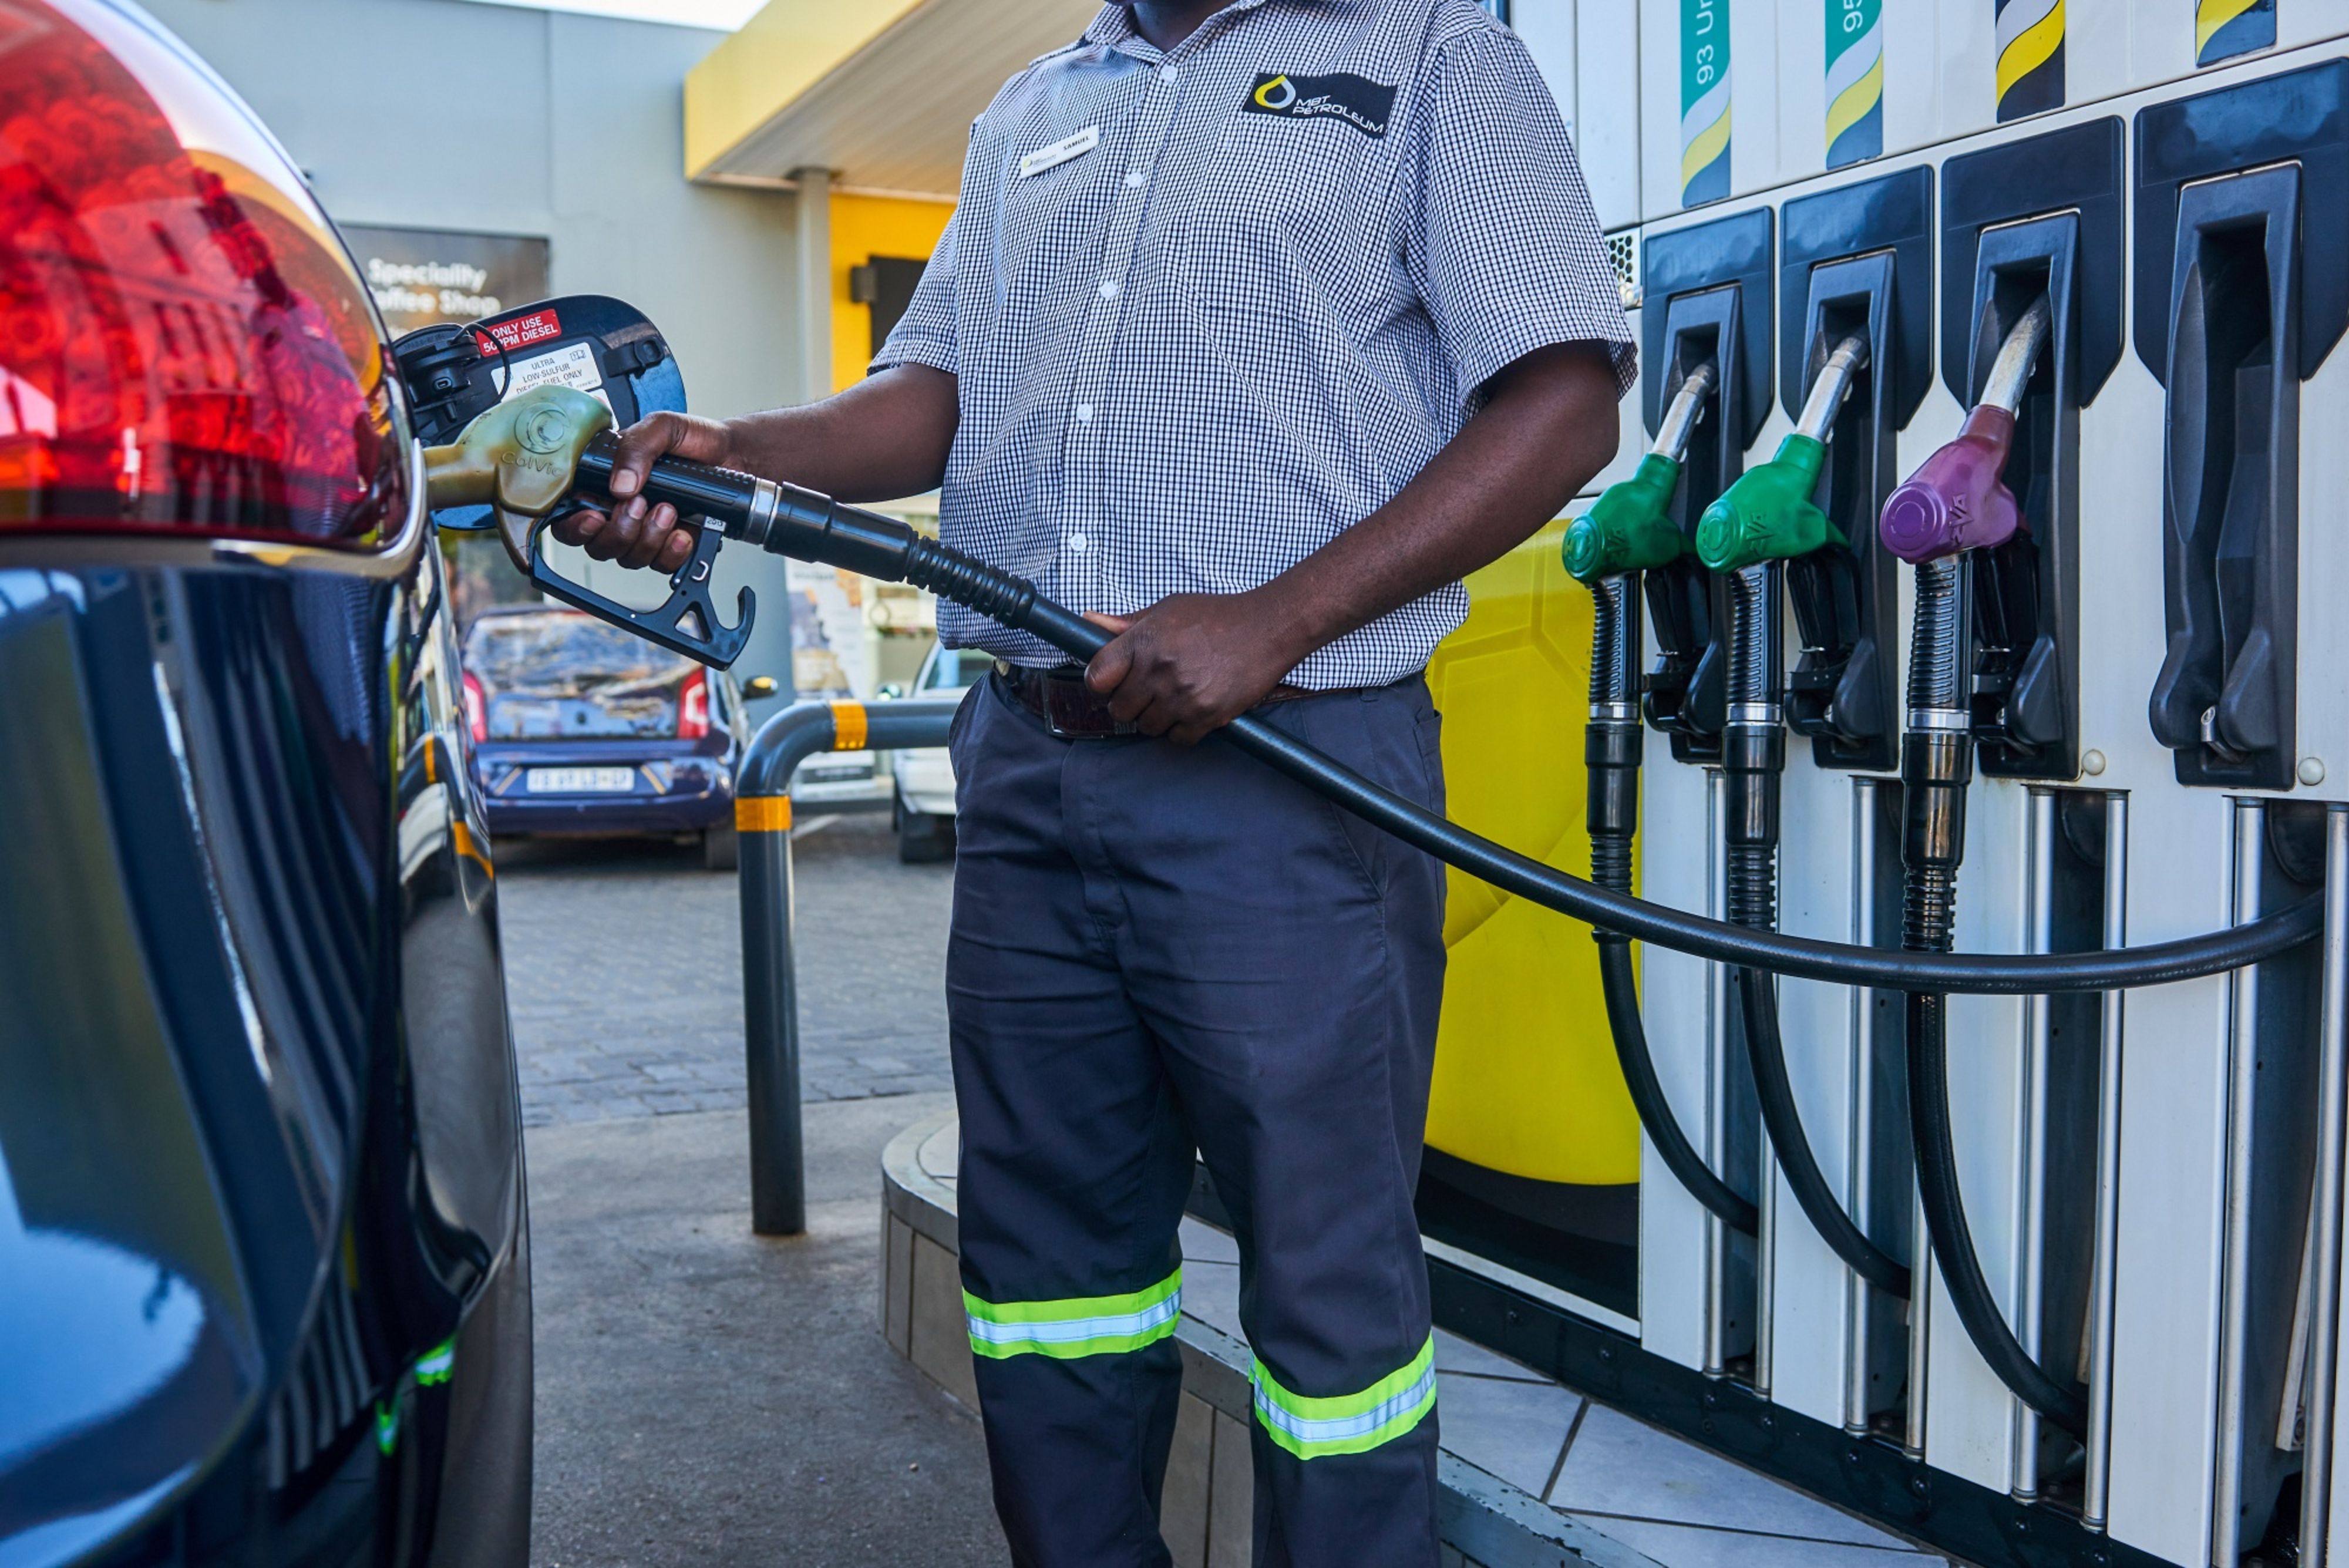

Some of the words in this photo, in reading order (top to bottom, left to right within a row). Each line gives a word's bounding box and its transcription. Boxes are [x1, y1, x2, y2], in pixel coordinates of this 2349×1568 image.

[1697, 44, 1714, 84] 93
[1296, 95, 1331, 106] MBT
[1293, 103, 1384, 133] PETROLEUM
[1064, 136, 1089, 151] SAMUEL
[439, 290, 502, 317] Shop
[492, 322, 518, 338] ONLY
[521, 316, 543, 329] USE
[522, 324, 558, 342] DIESEL
[522, 362, 570, 383] LOW-SULFUR
[531, 358, 555, 369] ULTRA
[564, 369, 583, 381] ONLY
